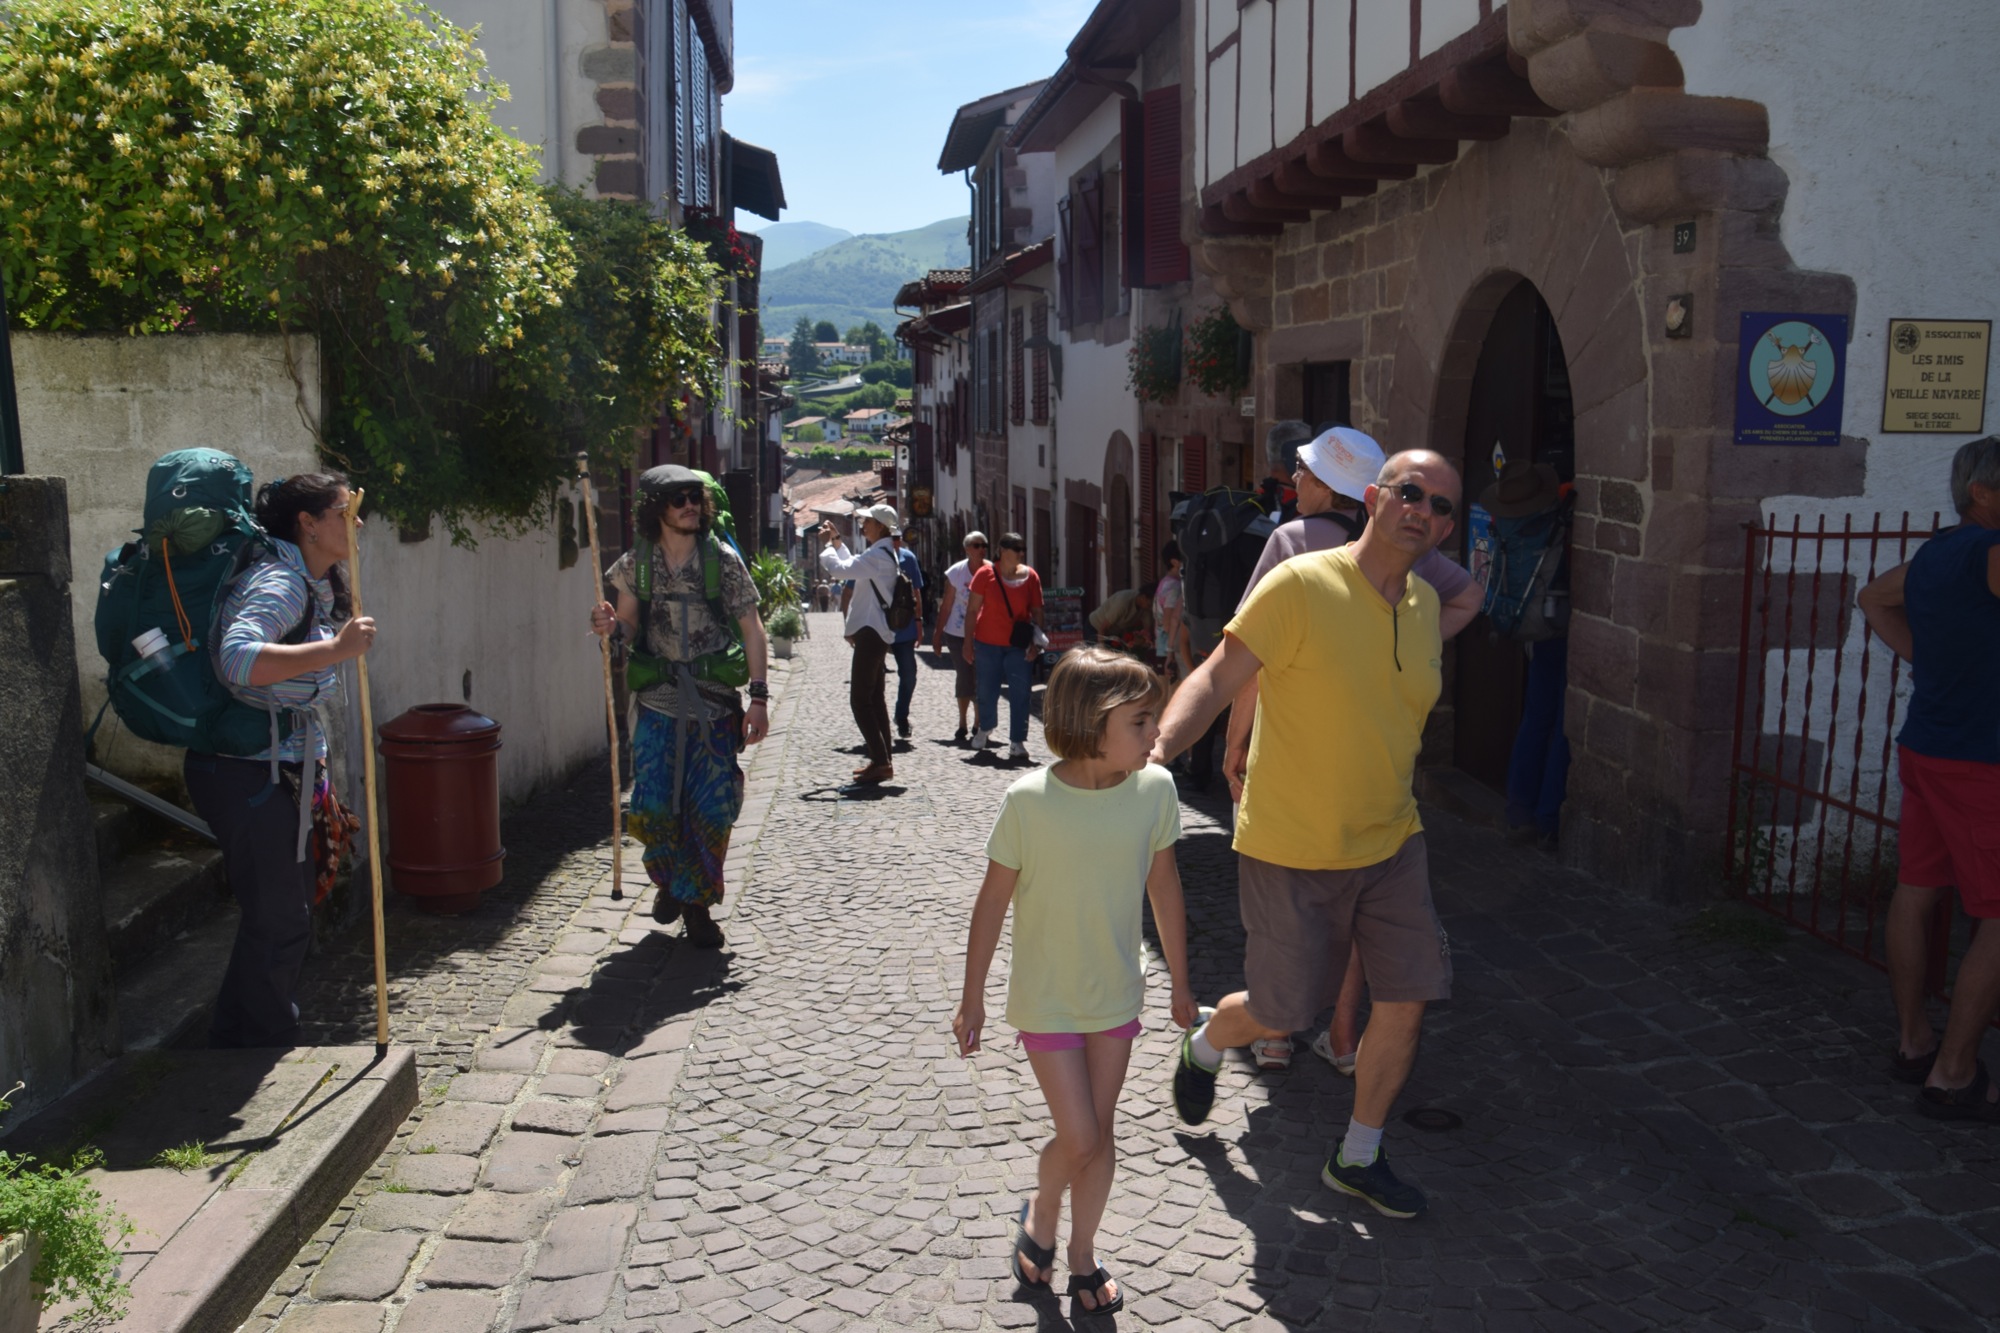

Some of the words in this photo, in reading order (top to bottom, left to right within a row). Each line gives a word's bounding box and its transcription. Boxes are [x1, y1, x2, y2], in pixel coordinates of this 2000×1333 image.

[1676, 230, 1690, 246] 39
[1925, 330, 1982, 339] ASSOCIATION
[1912, 355, 1933, 365] LES
[1936, 355, 1964, 365] AMIS
[1921, 372, 1935, 382] DE
[1938, 372, 1951, 382] LA
[1890, 388, 1929, 399] VIEILLE
[1932, 389, 1981, 400] NAVARRE
[1905, 412, 1929, 420] SIEGE
[1931, 412, 1961, 420] SOCIAL
